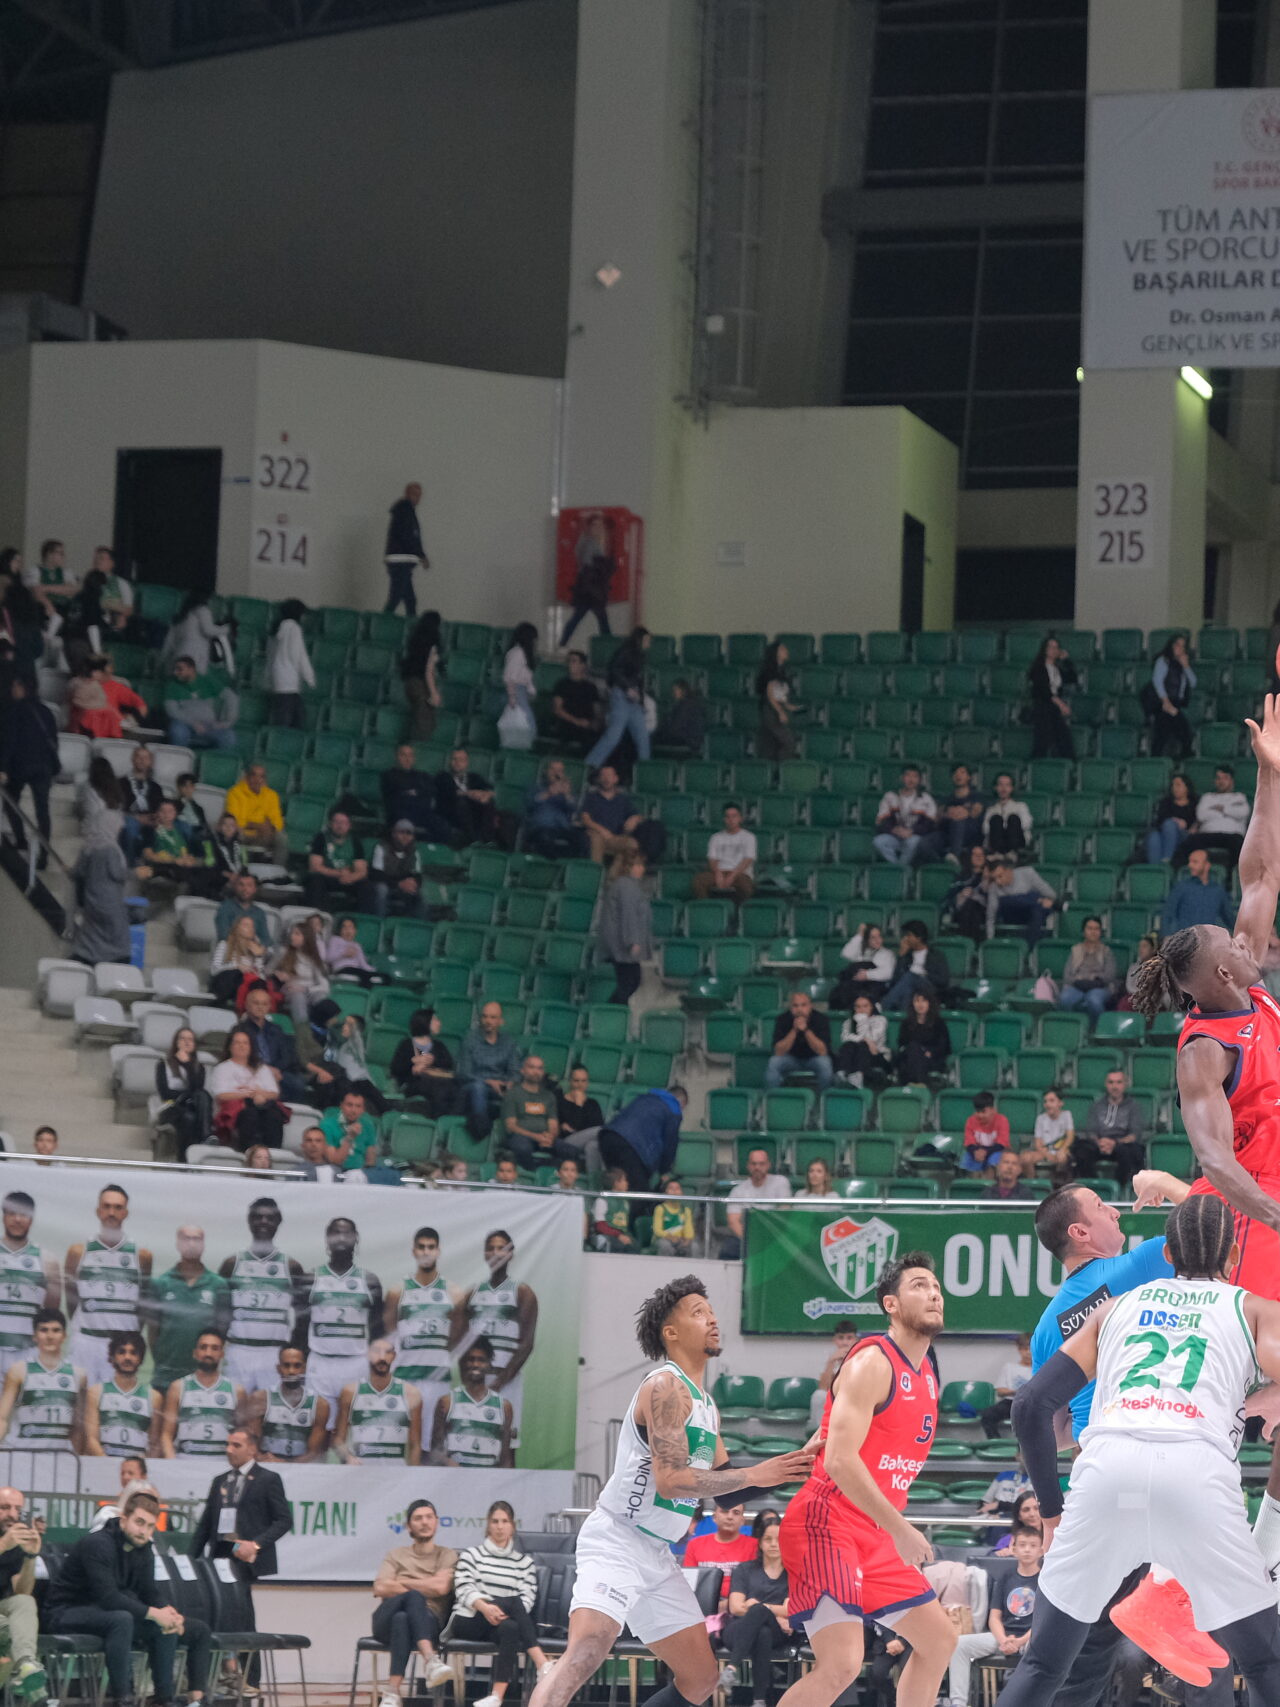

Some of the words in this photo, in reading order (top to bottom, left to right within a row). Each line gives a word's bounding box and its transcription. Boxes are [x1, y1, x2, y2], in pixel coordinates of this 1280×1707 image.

[1156, 203, 1221, 234] TÜM
[1122, 238, 1158, 263] VE
[1132, 269, 1265, 295] BAŞARILAR
[1169, 308, 1196, 325] Dr.
[1200, 308, 1265, 324] Osman
[1140, 331, 1226, 356] GENÇLİK
[1230, 332, 1254, 349] VE
[260, 454, 310, 493] 322
[1095, 482, 1148, 517] 323
[256, 527, 307, 566] 214
[1098, 530, 1145, 563] 215
[1137, 1288, 1221, 1307] BROWN
[1119, 1330, 1208, 1394] 21
[915, 1414, 934, 1444] 5
